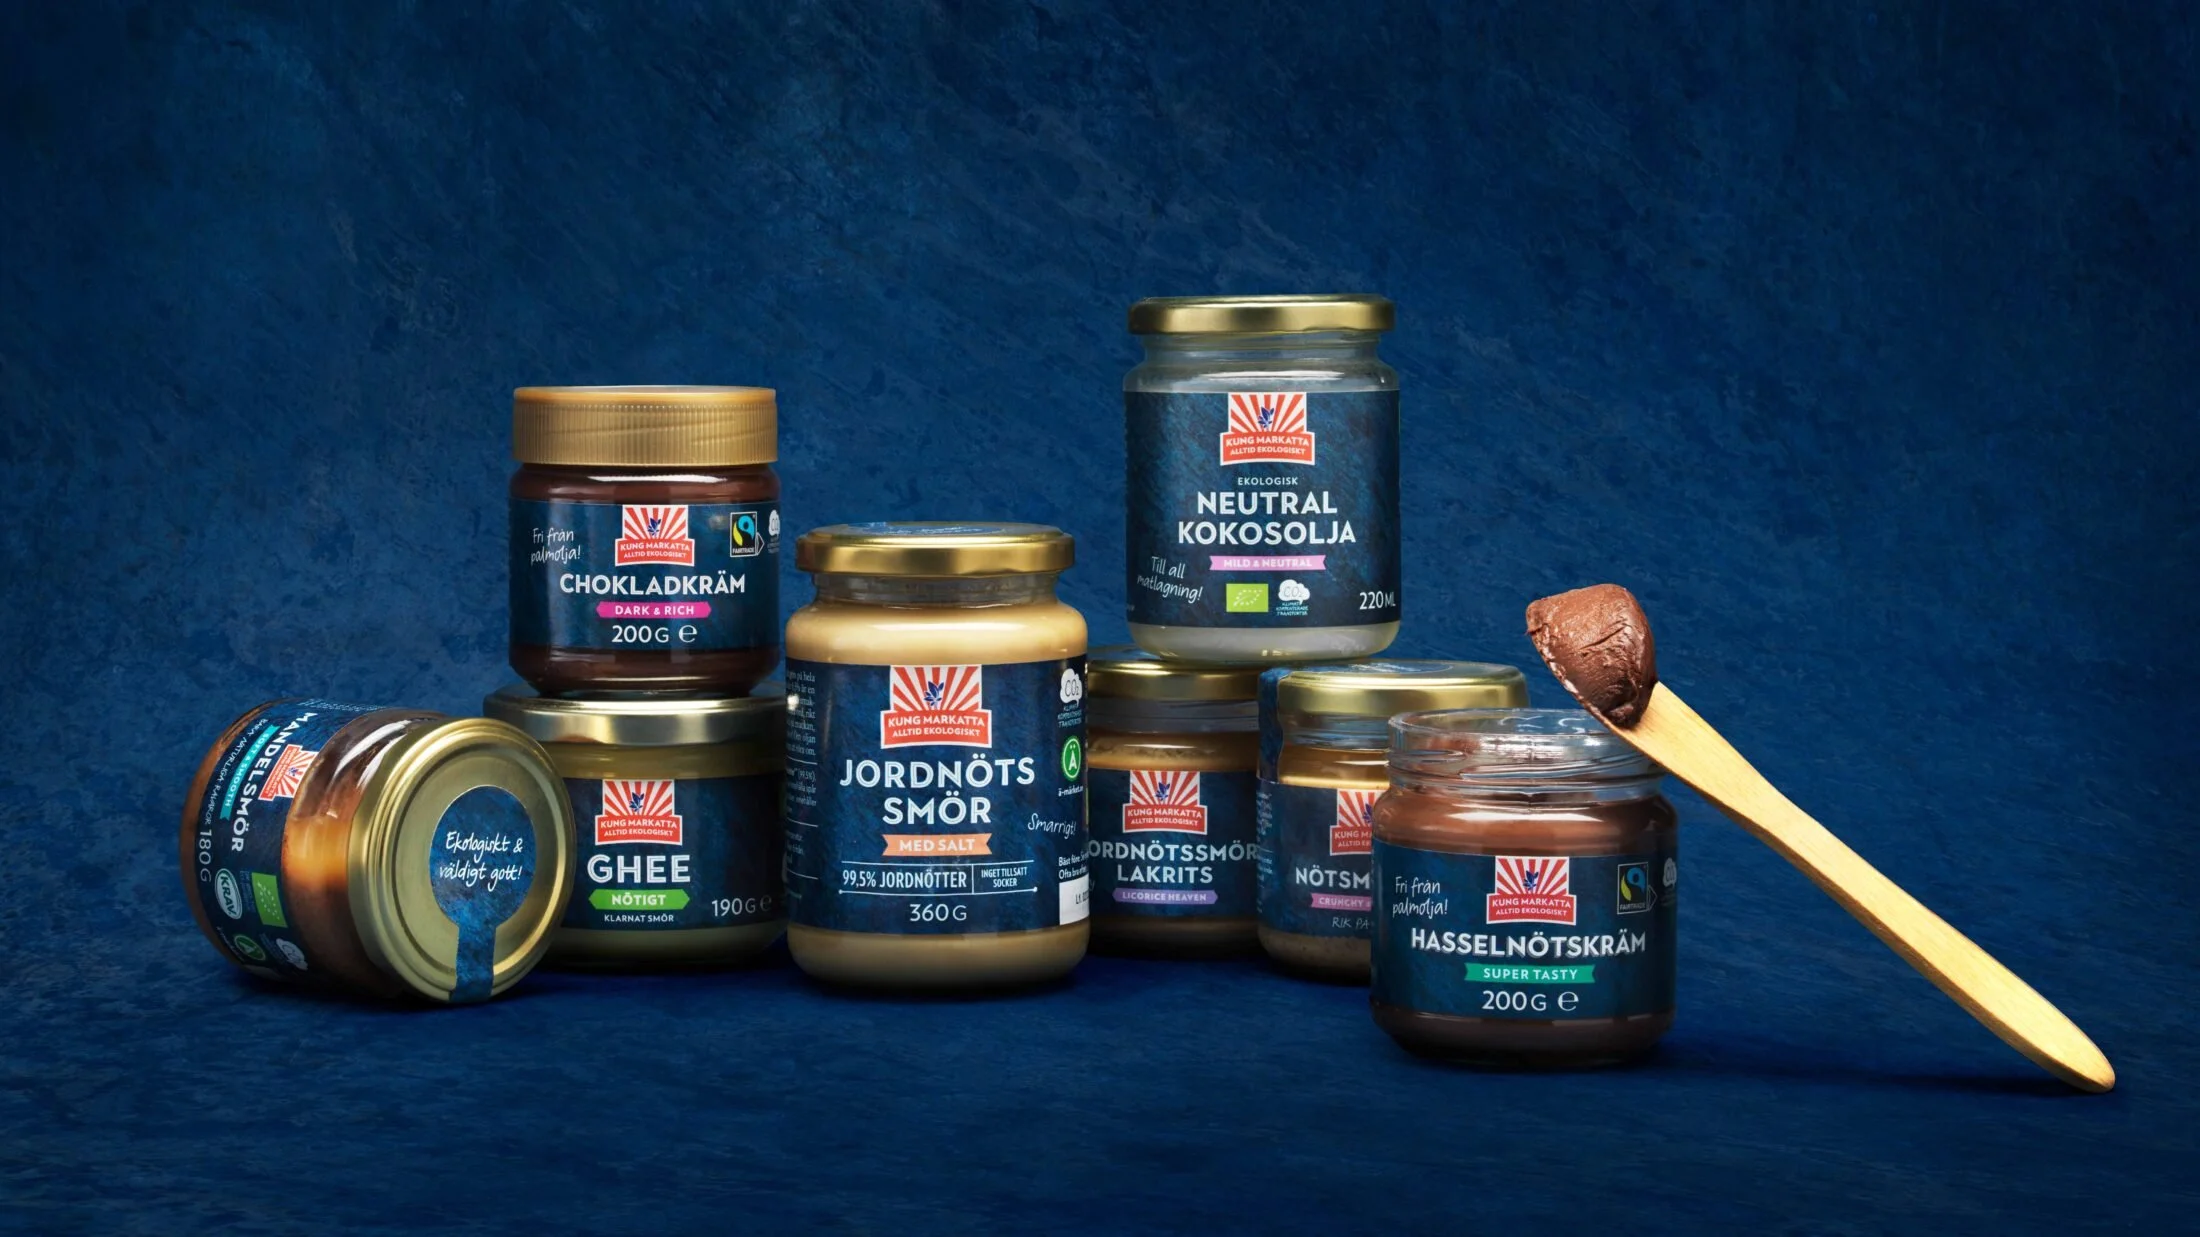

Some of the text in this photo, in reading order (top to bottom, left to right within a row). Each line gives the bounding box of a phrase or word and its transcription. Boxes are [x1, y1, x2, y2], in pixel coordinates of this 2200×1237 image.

[1226, 436, 1309, 447] KUNG MARKATTA
[1230, 446, 1306, 455] ALLTID EKOLOGISKT
[1237, 477, 1298, 485] EKOLOGISK
[1197, 491, 1337, 515] NEUTRAL
[533, 527, 544, 544] Fri
[1178, 520, 1356, 545] KOKOSOLJA
[620, 541, 690, 551] KUNG MARKATTA
[531, 544, 580, 567] palmolja!
[624, 551, 646, 559] ALLTID
[1151, 556, 1186, 579] Till all
[1223, 558, 1251, 568] MILD
[1262, 558, 1312, 568] NEUTRAL
[559, 570, 746, 595] CHOKLADKRÄM
[1137, 575, 1203, 604] matlagning!
[615, 604, 695, 616] DARK & RICH
[888, 713, 986, 728] KUNG MARKATTA
[892, 726, 981, 738] ALLTID EKOLOGISKT
[248, 732, 271, 758] SOFT
[217, 736, 248, 783] NATURLIGA
[839, 753, 1036, 790] JORDNÖTS
[224, 759, 249, 808] SMOOTH
[231, 712, 318, 852] MANDELSMÖR
[882, 790, 992, 825] SMÖR
[1127, 808, 1202, 818] KUNG MARKATTA
[600, 818, 677, 829] KUNG MARKATTA
[1028, 813, 1076, 839] Smarrigt!
[1130, 817, 1199, 826] ALLTID EKOLOGISKT
[604, 828, 673, 837] ALLTID EKOLOGISKT
[1334, 831, 1360, 840] KUNG
[445, 831, 524, 863] Ekologiskt &
[900, 838, 975, 852] MED SALT
[1088, 839, 1258, 862] ORDNÖTSSMÖR
[587, 854, 691, 884] GHEE
[981, 867, 1028, 878] INGET TILLSATT
[1059, 868, 1072, 880] Ofta
[1117, 865, 1213, 884] LAKRITS
[1296, 864, 1370, 889] NÖTSM
[439, 864, 523, 891] väldigt gott!
[879, 867, 967, 890] JORDNÖTTER
[992, 877, 1018, 888] SOCKER
[1395, 876, 1408, 894] Fri
[220, 872, 237, 915] KRAV
[611, 892, 667, 906] NÖTIGT
[1122, 892, 1207, 902] LICORICE HEAVEN
[1319, 897, 1363, 907] CRUNCHY
[1392, 897, 1448, 919] palmolja!
[1492, 897, 1572, 909] KUNG MARKATTA
[604, 912, 675, 923] KLARNAT SMÖR
[1495, 906, 1568, 917] ALLTID EKOLOGISKT
[1332, 916, 1352, 928] RIK
[1411, 927, 1647, 958] HASSELNÖTSKRÄM
[1483, 968, 1579, 981] SUPER TASTY
